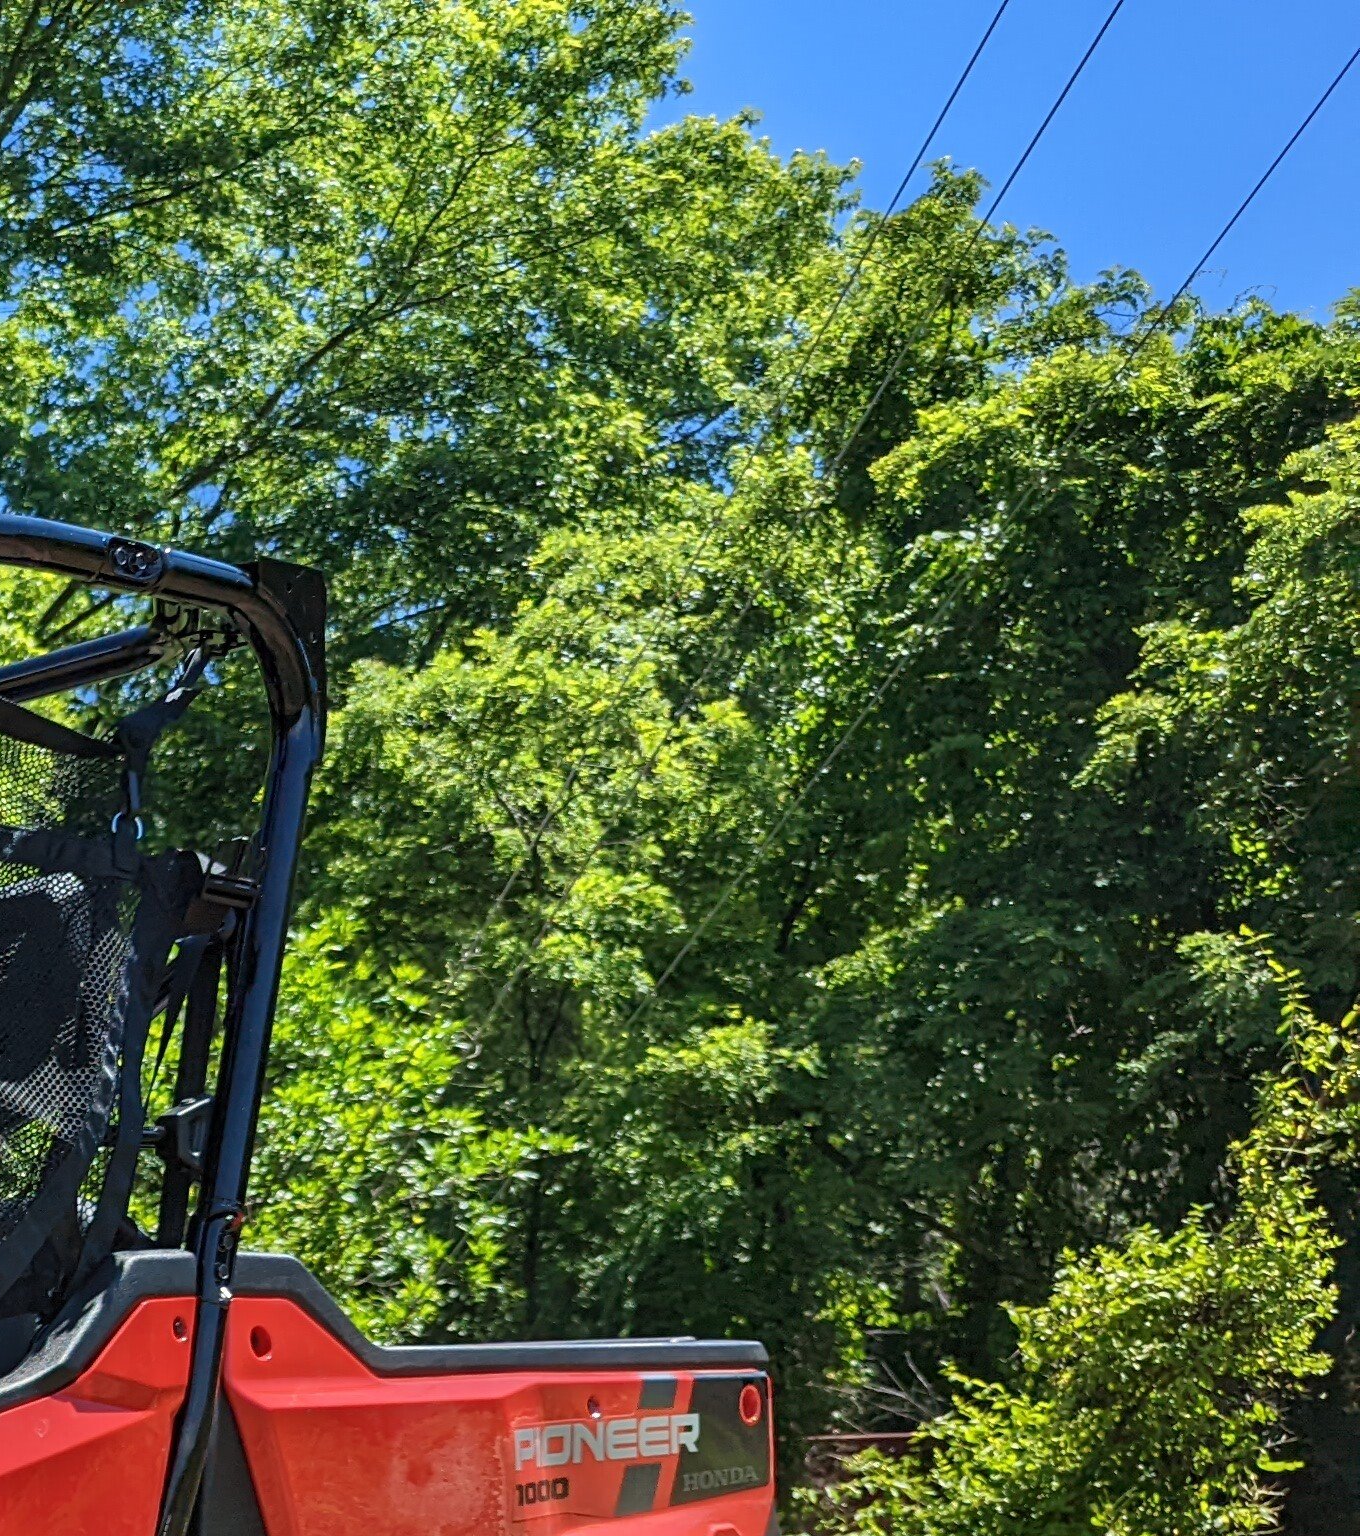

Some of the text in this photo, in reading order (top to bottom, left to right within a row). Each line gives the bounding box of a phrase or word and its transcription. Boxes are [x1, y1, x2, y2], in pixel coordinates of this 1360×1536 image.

[514, 1413, 701, 1471] PIONEER
[515, 1476, 570, 1506] 1000
[683, 1465, 760, 1492] HONDA
